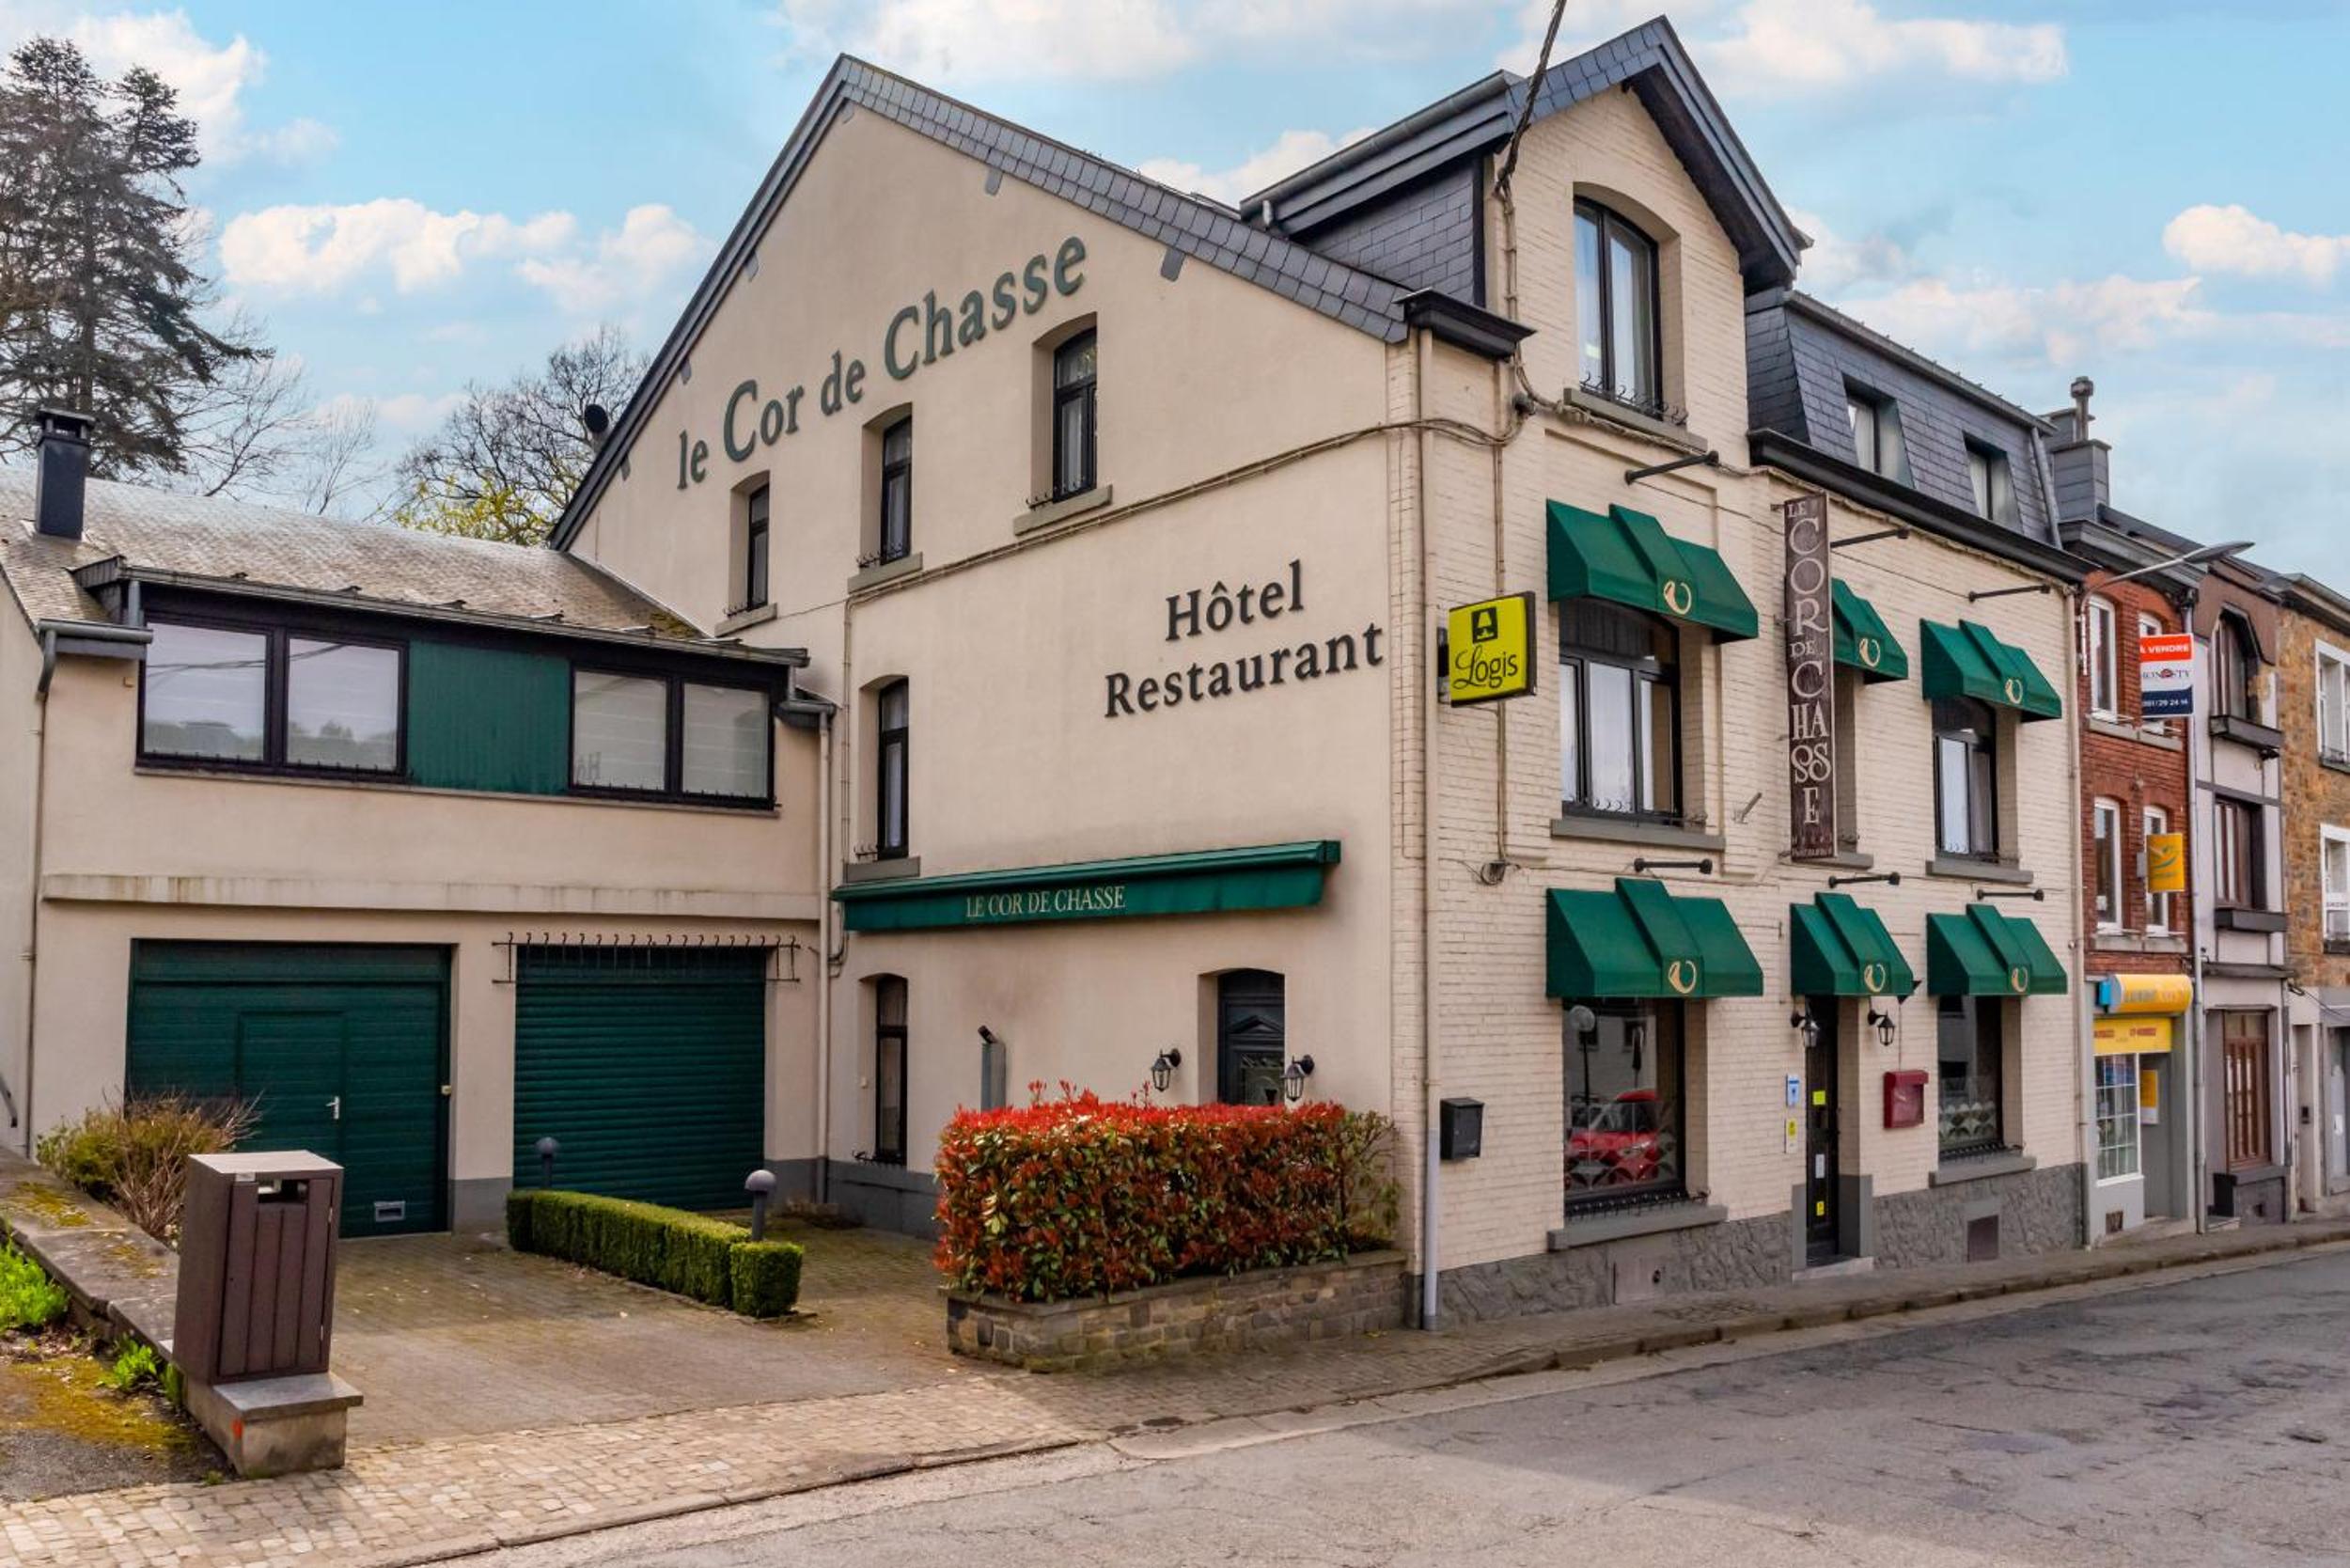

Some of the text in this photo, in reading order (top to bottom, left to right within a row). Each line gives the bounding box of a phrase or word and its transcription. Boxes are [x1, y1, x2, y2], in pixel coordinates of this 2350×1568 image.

[676, 235, 1088, 491] le Cor de Chasse
[1165, 558, 1304, 642] Hôtel
[1104, 621, 1384, 719] Restaurant
[1452, 645, 1518, 689] Logis
[966, 885, 1126, 917] LE COR DE CHASSE
